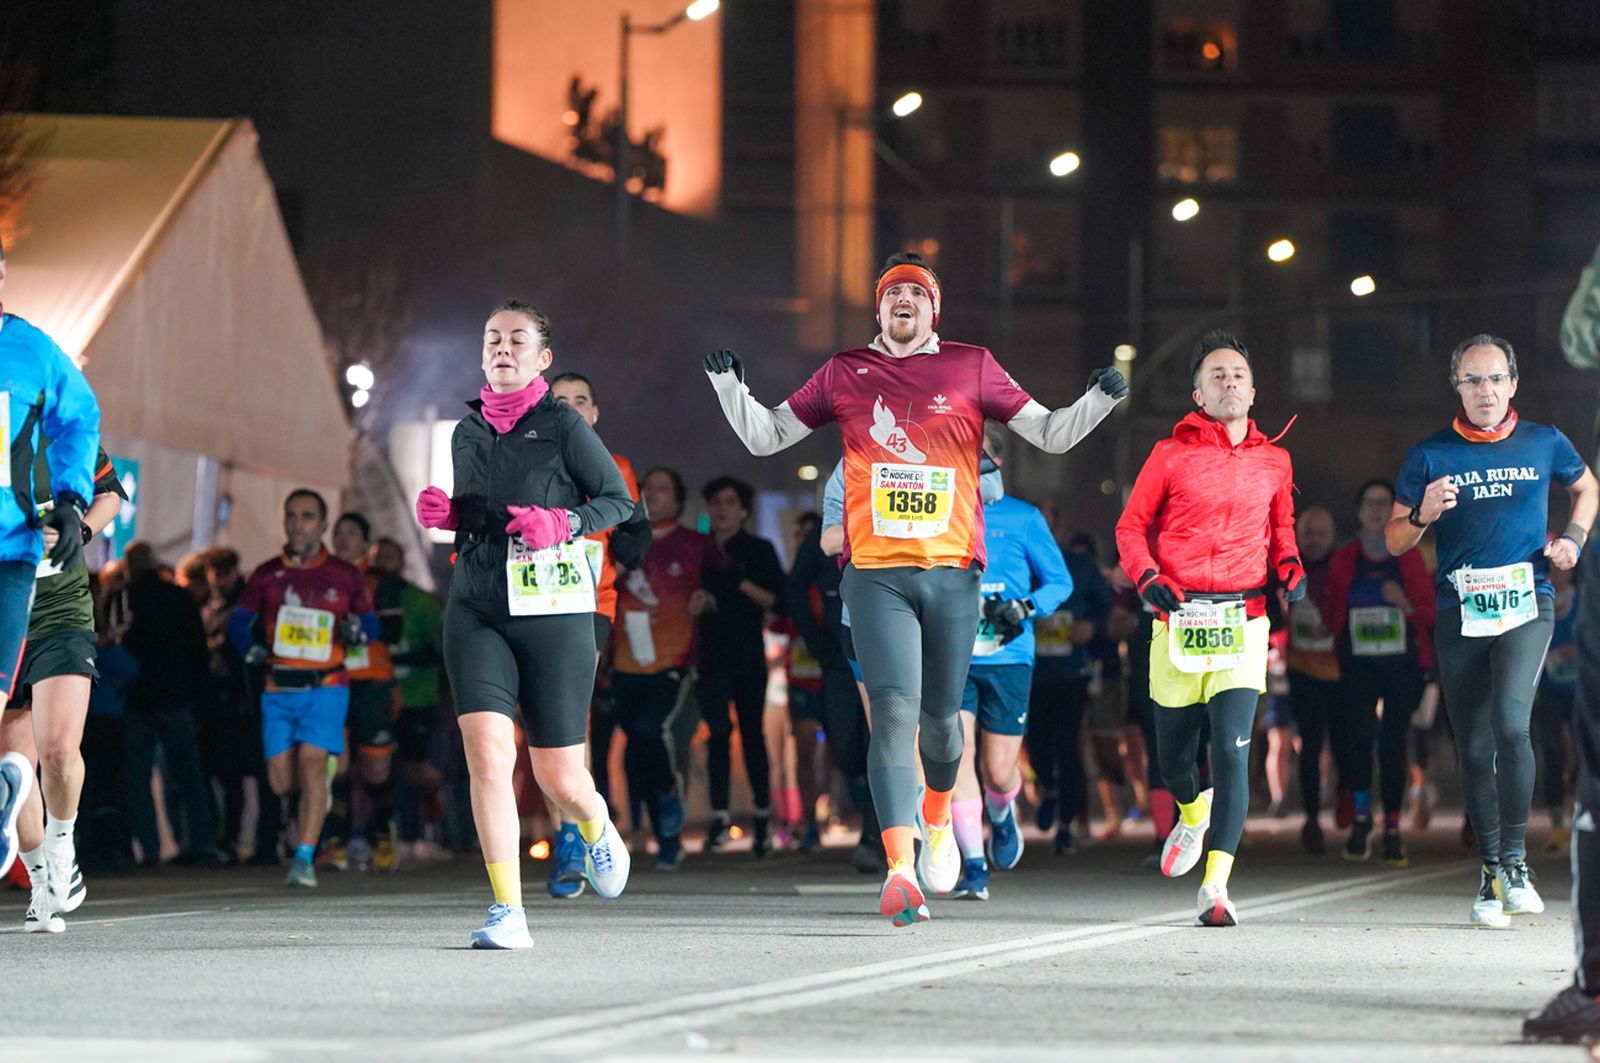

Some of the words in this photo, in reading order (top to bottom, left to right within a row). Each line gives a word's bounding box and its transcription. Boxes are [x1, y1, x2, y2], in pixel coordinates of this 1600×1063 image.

[885, 432, 907, 454] 43
[889, 472, 914, 480] NOCHE
[1486, 466, 1540, 483] RURAL
[880, 480, 896, 489] SAN
[897, 480, 924, 490] ANTÓN
[1472, 482, 1513, 500] JAÉN
[887, 490, 937, 514] 1358
[1473, 575, 1493, 584] NOCHE
[1474, 589, 1520, 613] 9476
[1186, 610, 1208, 618] NOCHE
[1178, 619, 1192, 627] SAN
[1183, 627, 1234, 649] 2856
